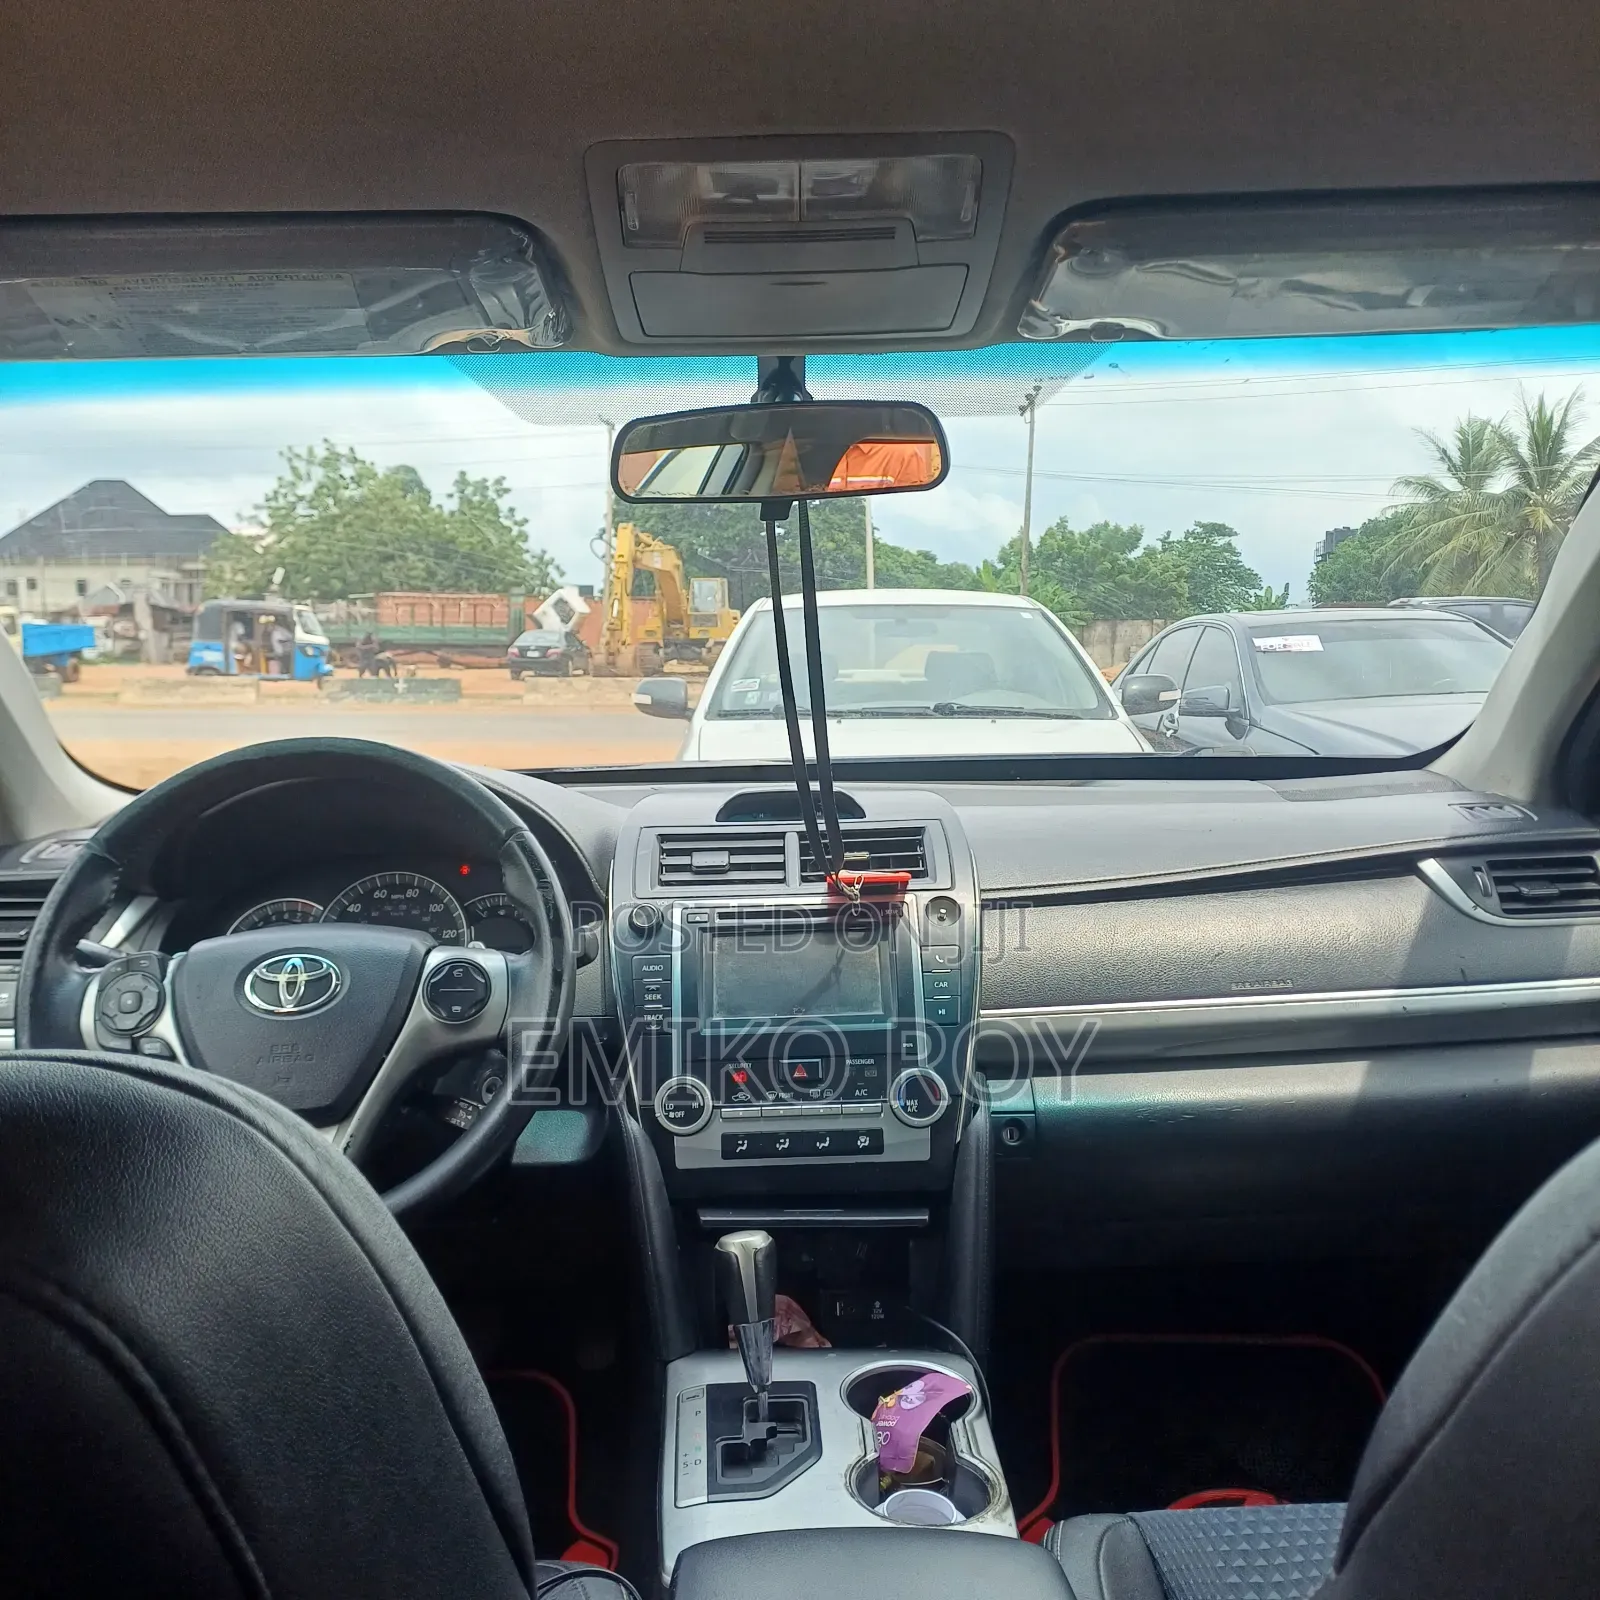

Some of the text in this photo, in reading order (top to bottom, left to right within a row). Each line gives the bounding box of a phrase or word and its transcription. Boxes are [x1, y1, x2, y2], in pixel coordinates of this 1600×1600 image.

[373, 889, 388, 899] 60
[405, 888, 420, 898] 80
[346, 903, 362, 913] 40
[428, 903, 444, 912] 100
[442, 929, 457, 938] 120
[674, 1110, 685, 1118] OFF
